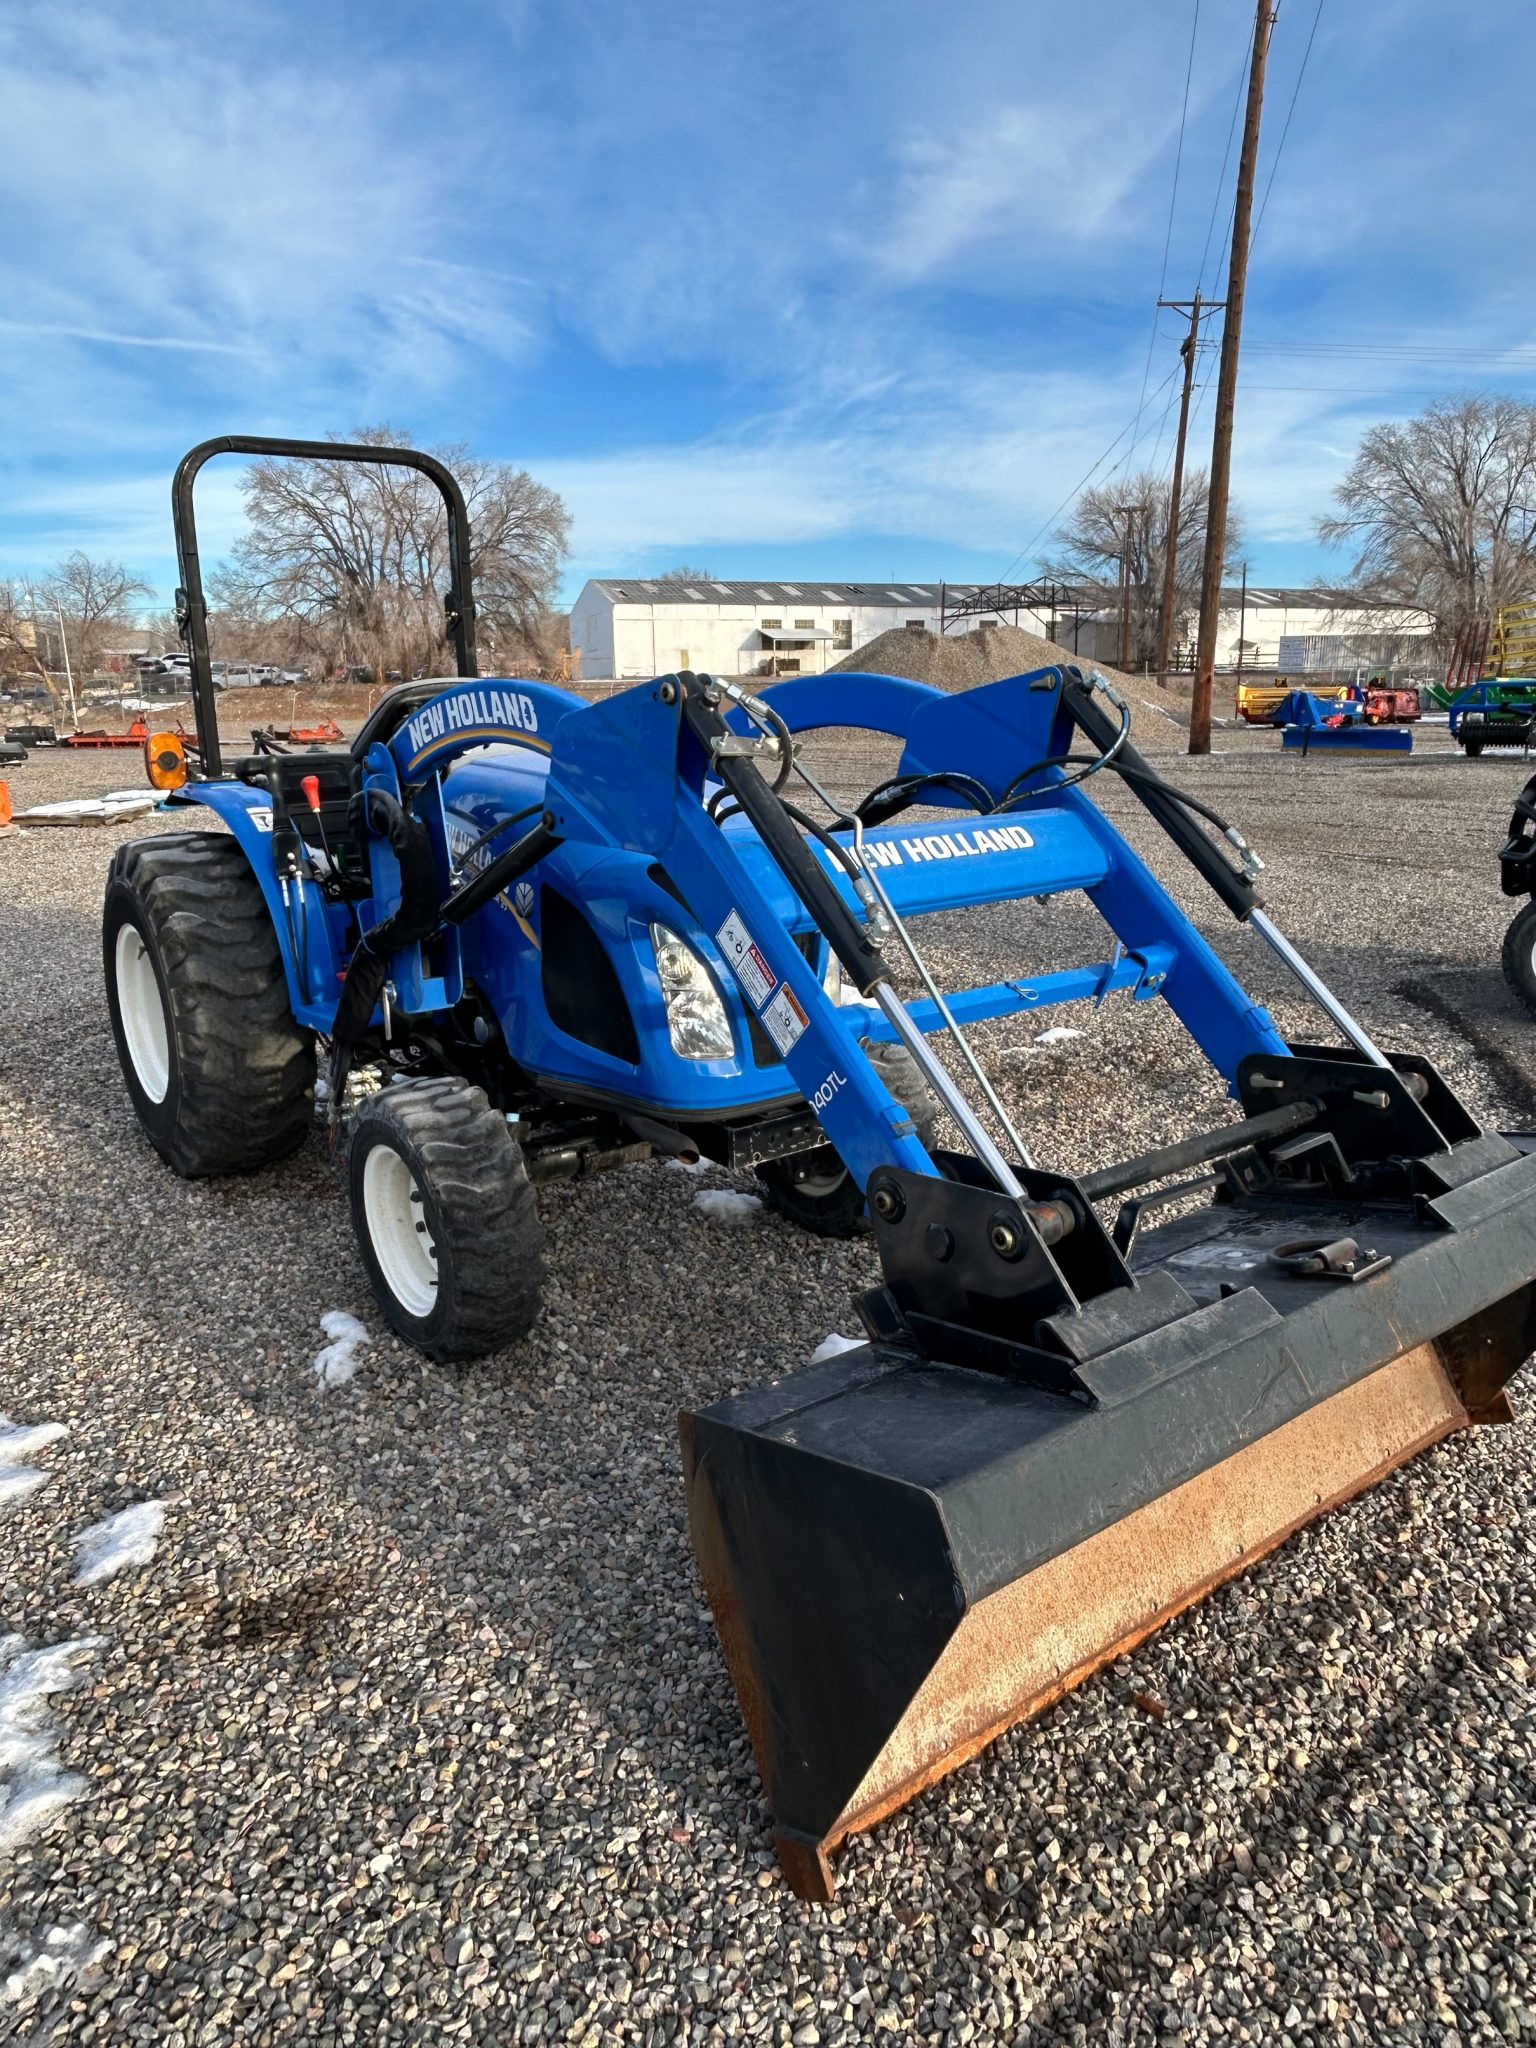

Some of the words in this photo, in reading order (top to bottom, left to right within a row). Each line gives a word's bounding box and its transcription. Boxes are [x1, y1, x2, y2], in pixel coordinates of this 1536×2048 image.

[408, 702, 445, 753] NEW
[444, 690, 538, 733] HOLLAND
[901, 826, 1035, 863] HOLLAND
